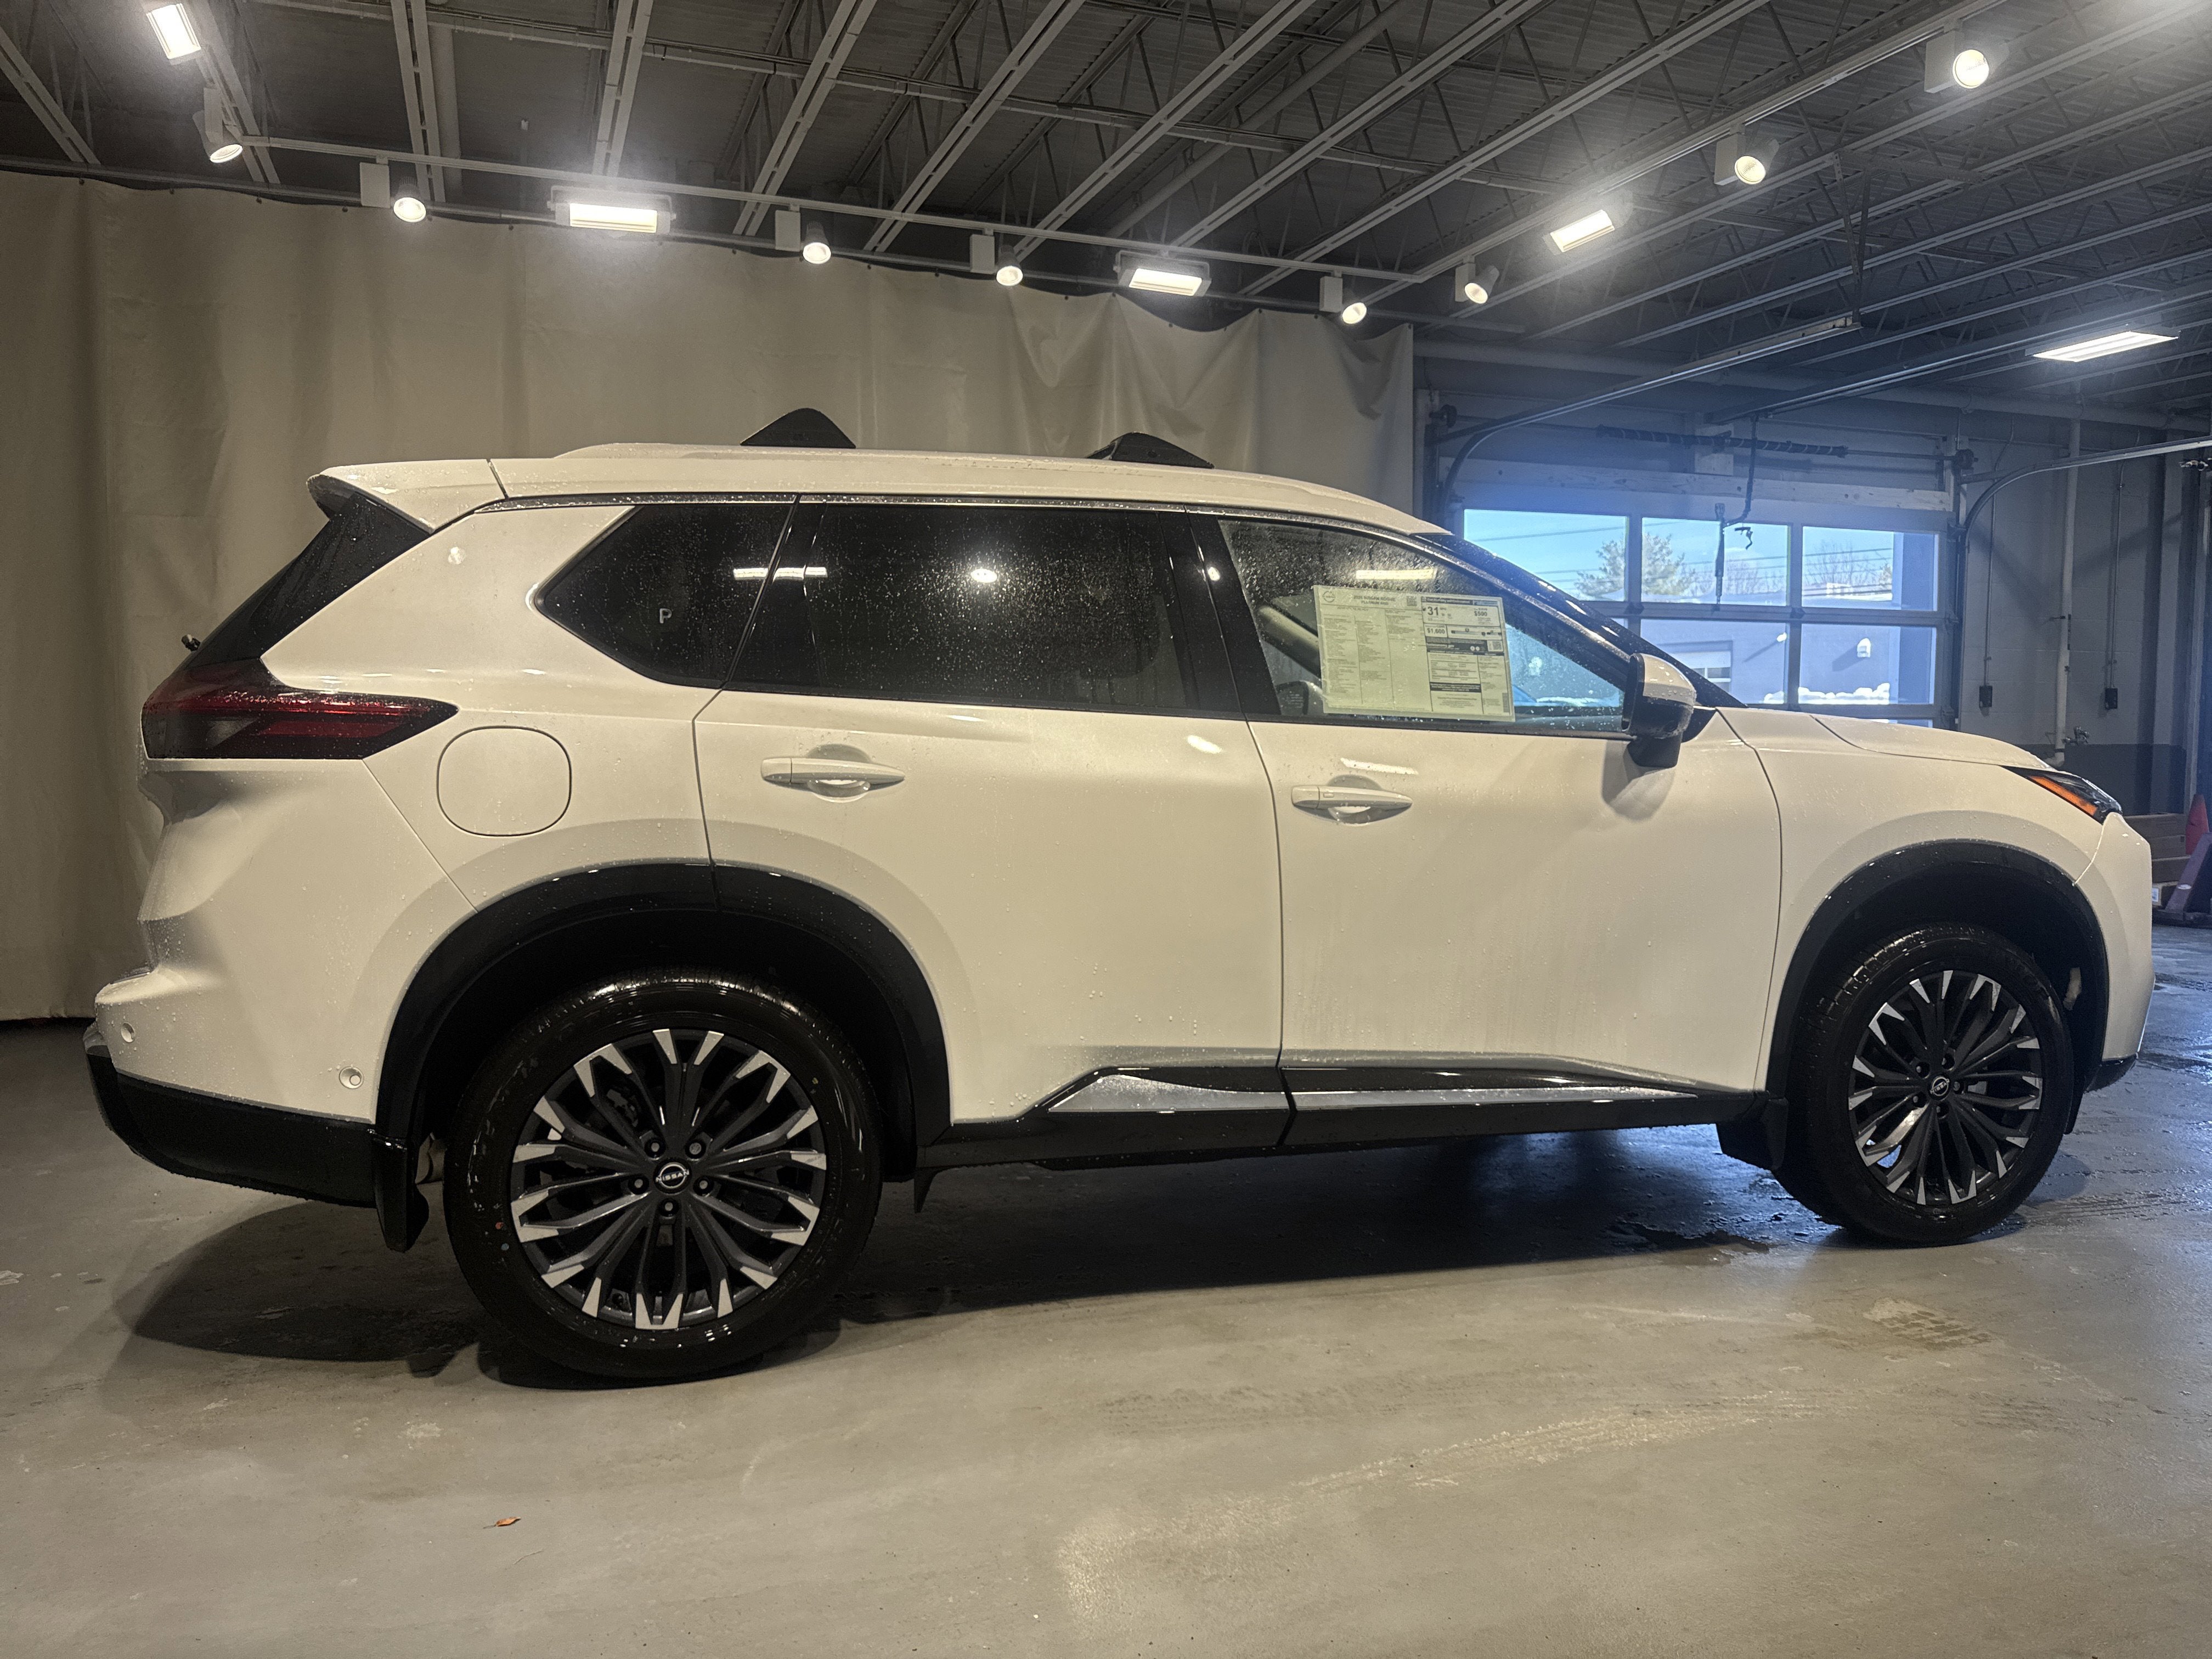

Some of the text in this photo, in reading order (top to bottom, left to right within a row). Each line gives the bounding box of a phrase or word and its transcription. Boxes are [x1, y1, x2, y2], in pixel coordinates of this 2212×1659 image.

[659, 608, 672, 624] P
[1427, 606, 1438, 616] 31
[656, 1169, 690, 1183] NISSAN
